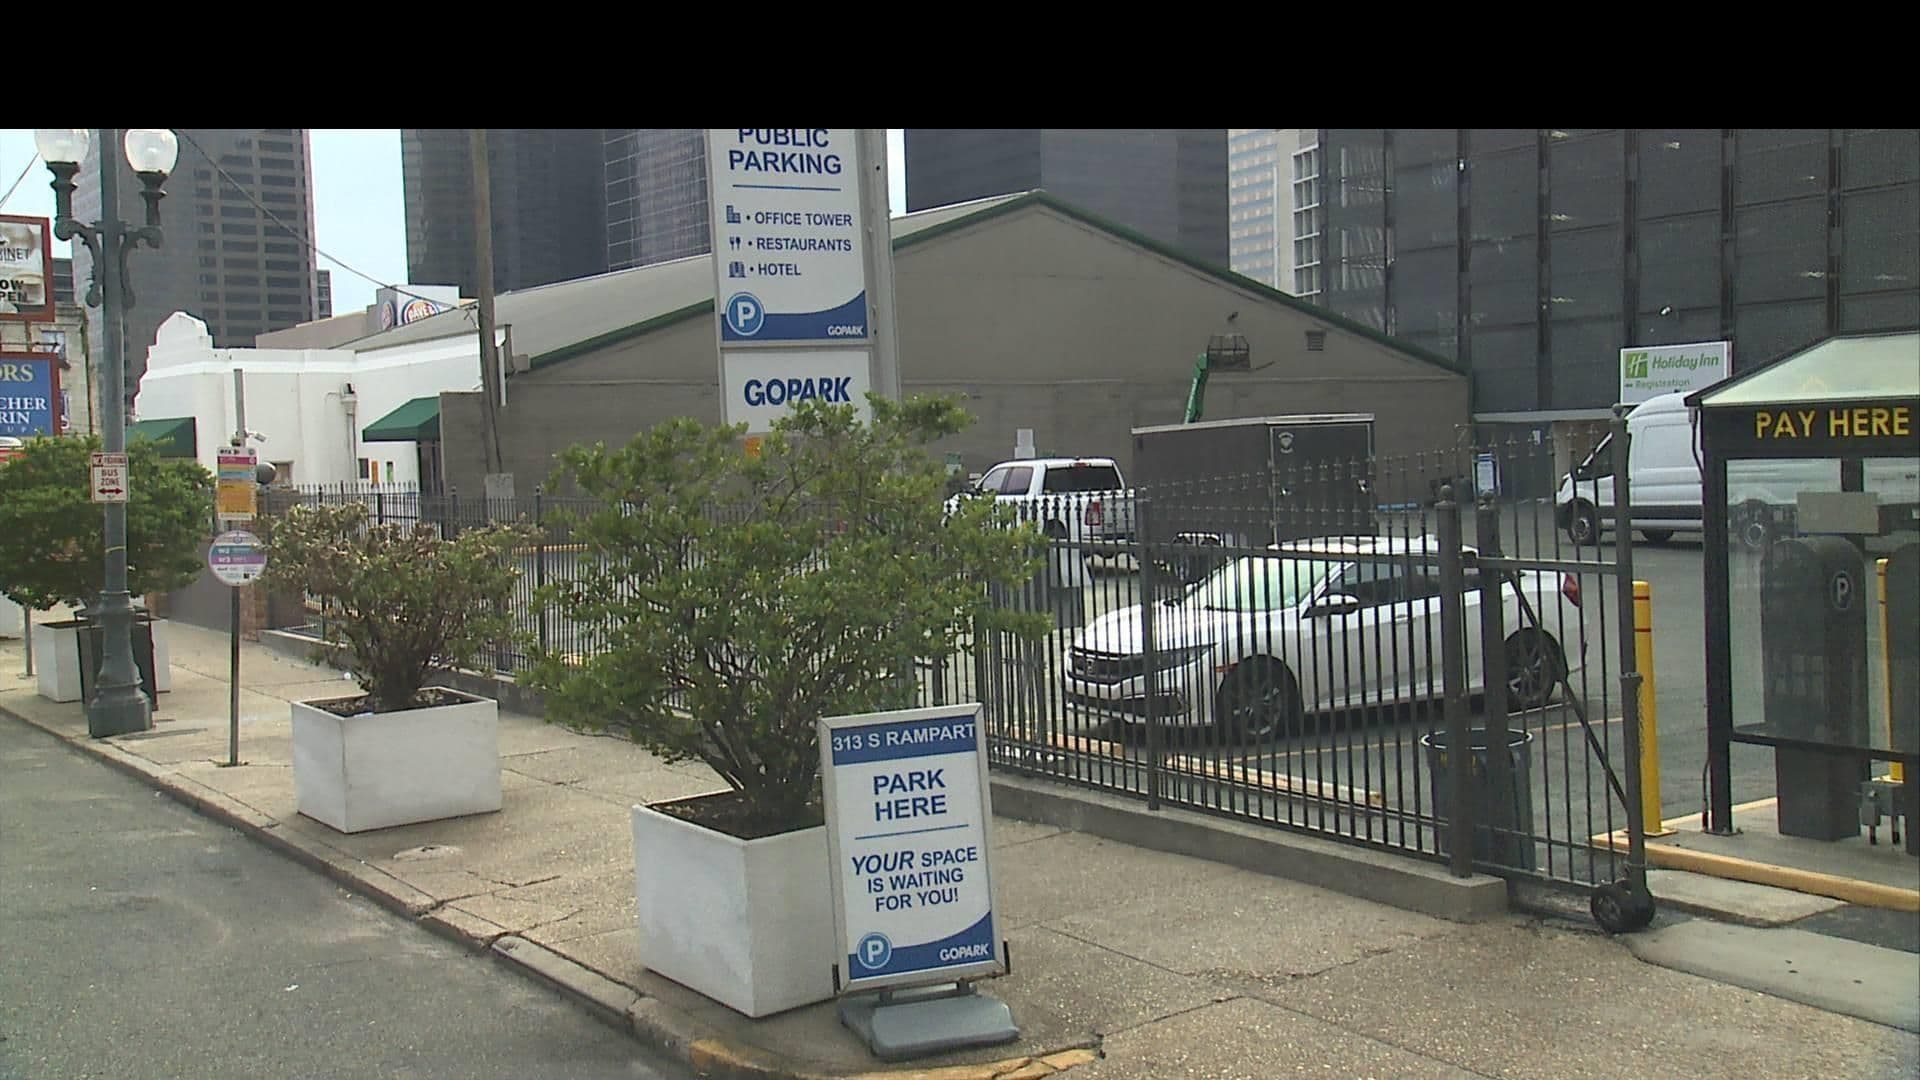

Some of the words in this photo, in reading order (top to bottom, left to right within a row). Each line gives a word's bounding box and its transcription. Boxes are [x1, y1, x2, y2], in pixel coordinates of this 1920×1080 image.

[738, 129, 830, 148] PUBLIC
[729, 150, 842, 174] PARKING
[754, 211, 802, 226] OFFICE
[805, 213, 853, 227] TOWER
[756, 237, 852, 252] RESTAURANTS
[758, 263, 802, 276] HOTEL
[737, 301, 756, 328] P
[827, 324, 864, 337] GOPARK
[1652, 354, 1700, 371] Holiday
[1700, 354, 1720, 369] Inn
[744, 376, 852, 407] GOPARK
[1635, 378, 1690, 390] Registration
[1755, 409, 1816, 439] PAY
[1829, 407, 1911, 437] HERE
[101, 469, 118, 477] BUS
[101, 478, 120, 486] ZONE
[833, 734, 863, 752] 313
[868, 732, 881, 748] S
[886, 723, 975, 746] RAMPART
[873, 768, 946, 796] PARK
[875, 795, 947, 822] HERE
[851, 850, 915, 876] YOUR
[921, 846, 978, 868] SPACE
[867, 877, 885, 894] IS
[889, 867, 964, 891] WAITING
[875, 893, 913, 913] FOR
[917, 888, 959, 907] YOU!
[867, 940, 883, 962] P
[939, 943, 989, 962] GOPARK
